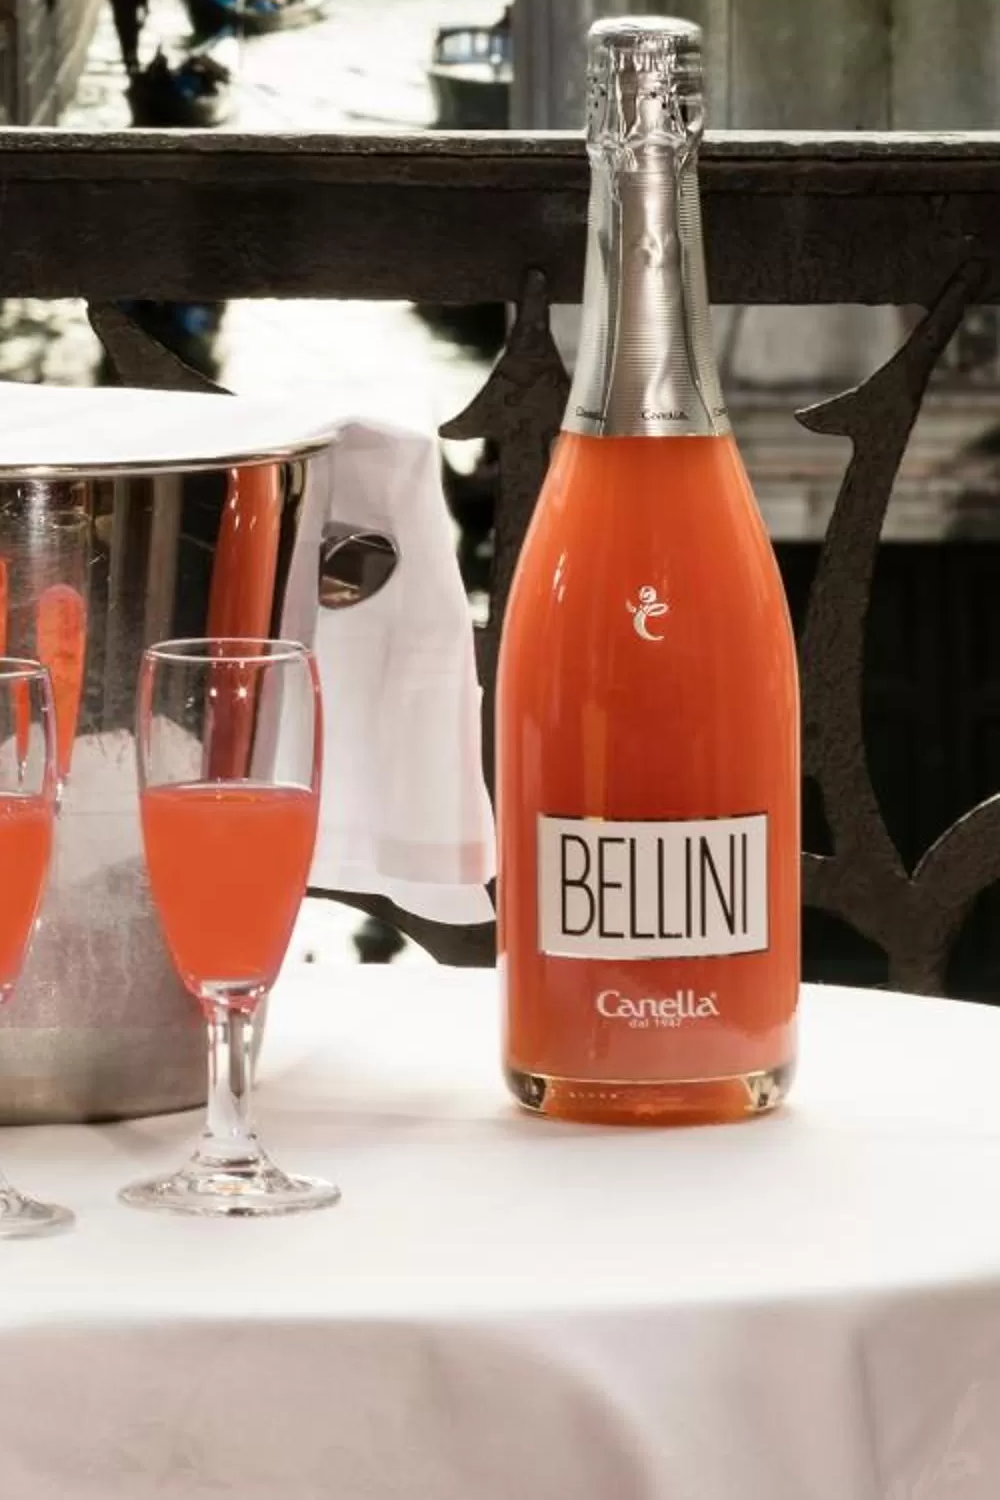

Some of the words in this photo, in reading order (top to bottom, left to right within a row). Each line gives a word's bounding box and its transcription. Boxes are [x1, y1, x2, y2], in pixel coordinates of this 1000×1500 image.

[560, 833, 748, 939] BELLINI
[596, 989, 720, 1018] Canella
[628, 1017, 649, 1029] dal
